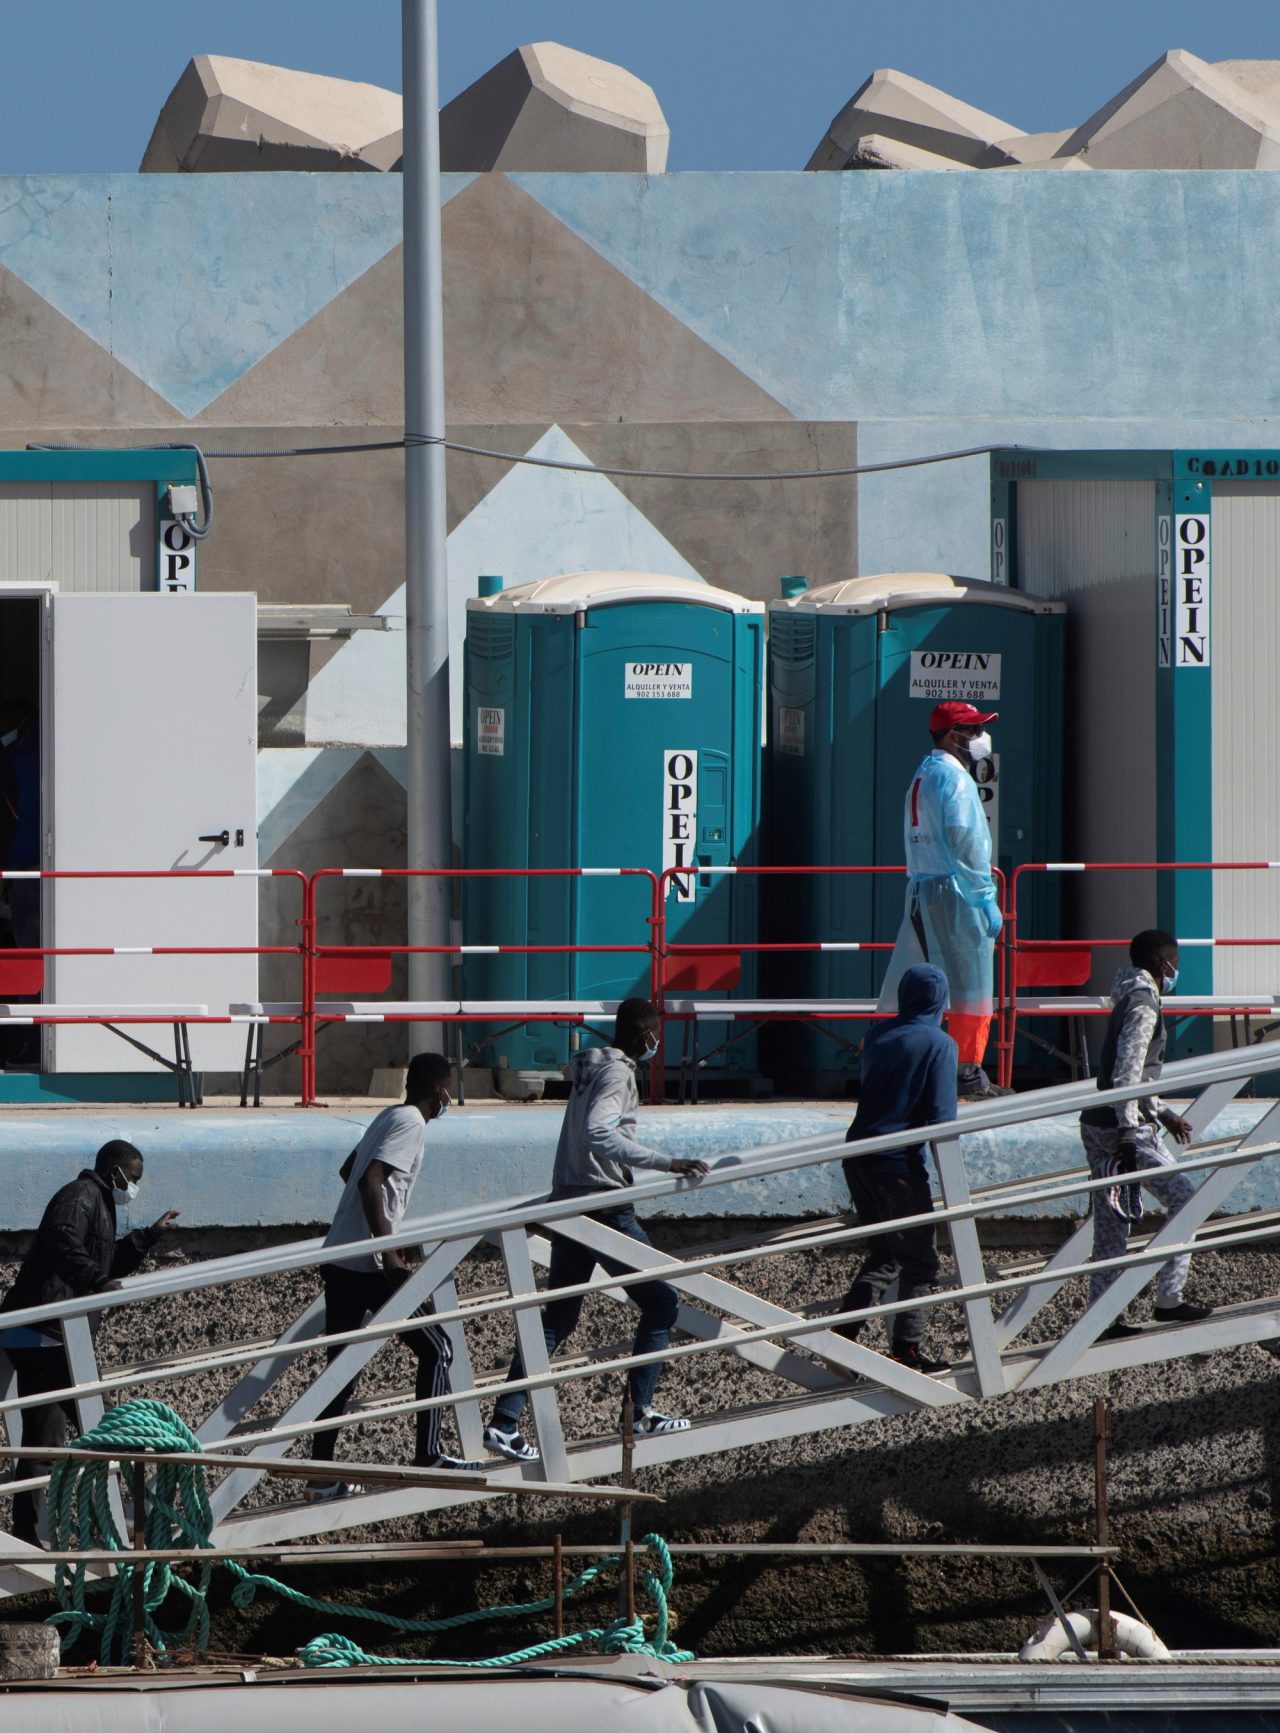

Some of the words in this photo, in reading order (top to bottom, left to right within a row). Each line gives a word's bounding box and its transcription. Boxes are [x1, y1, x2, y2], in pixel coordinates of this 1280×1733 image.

[1159, 519, 1170, 664] OPEIN
[1179, 517, 1207, 663] OPEIN
[632, 663, 684, 676] OPEIN
[920, 652, 991, 670] OPEIN
[912, 679, 958, 689] ALQUILER
[961, 680, 967, 689] Y
[969, 680, 998, 690] VENTA
[925, 689, 943, 698] 902
[946, 690, 963, 698] 153
[967, 690, 985, 699] 688
[667, 753, 694, 899] OPEIN
